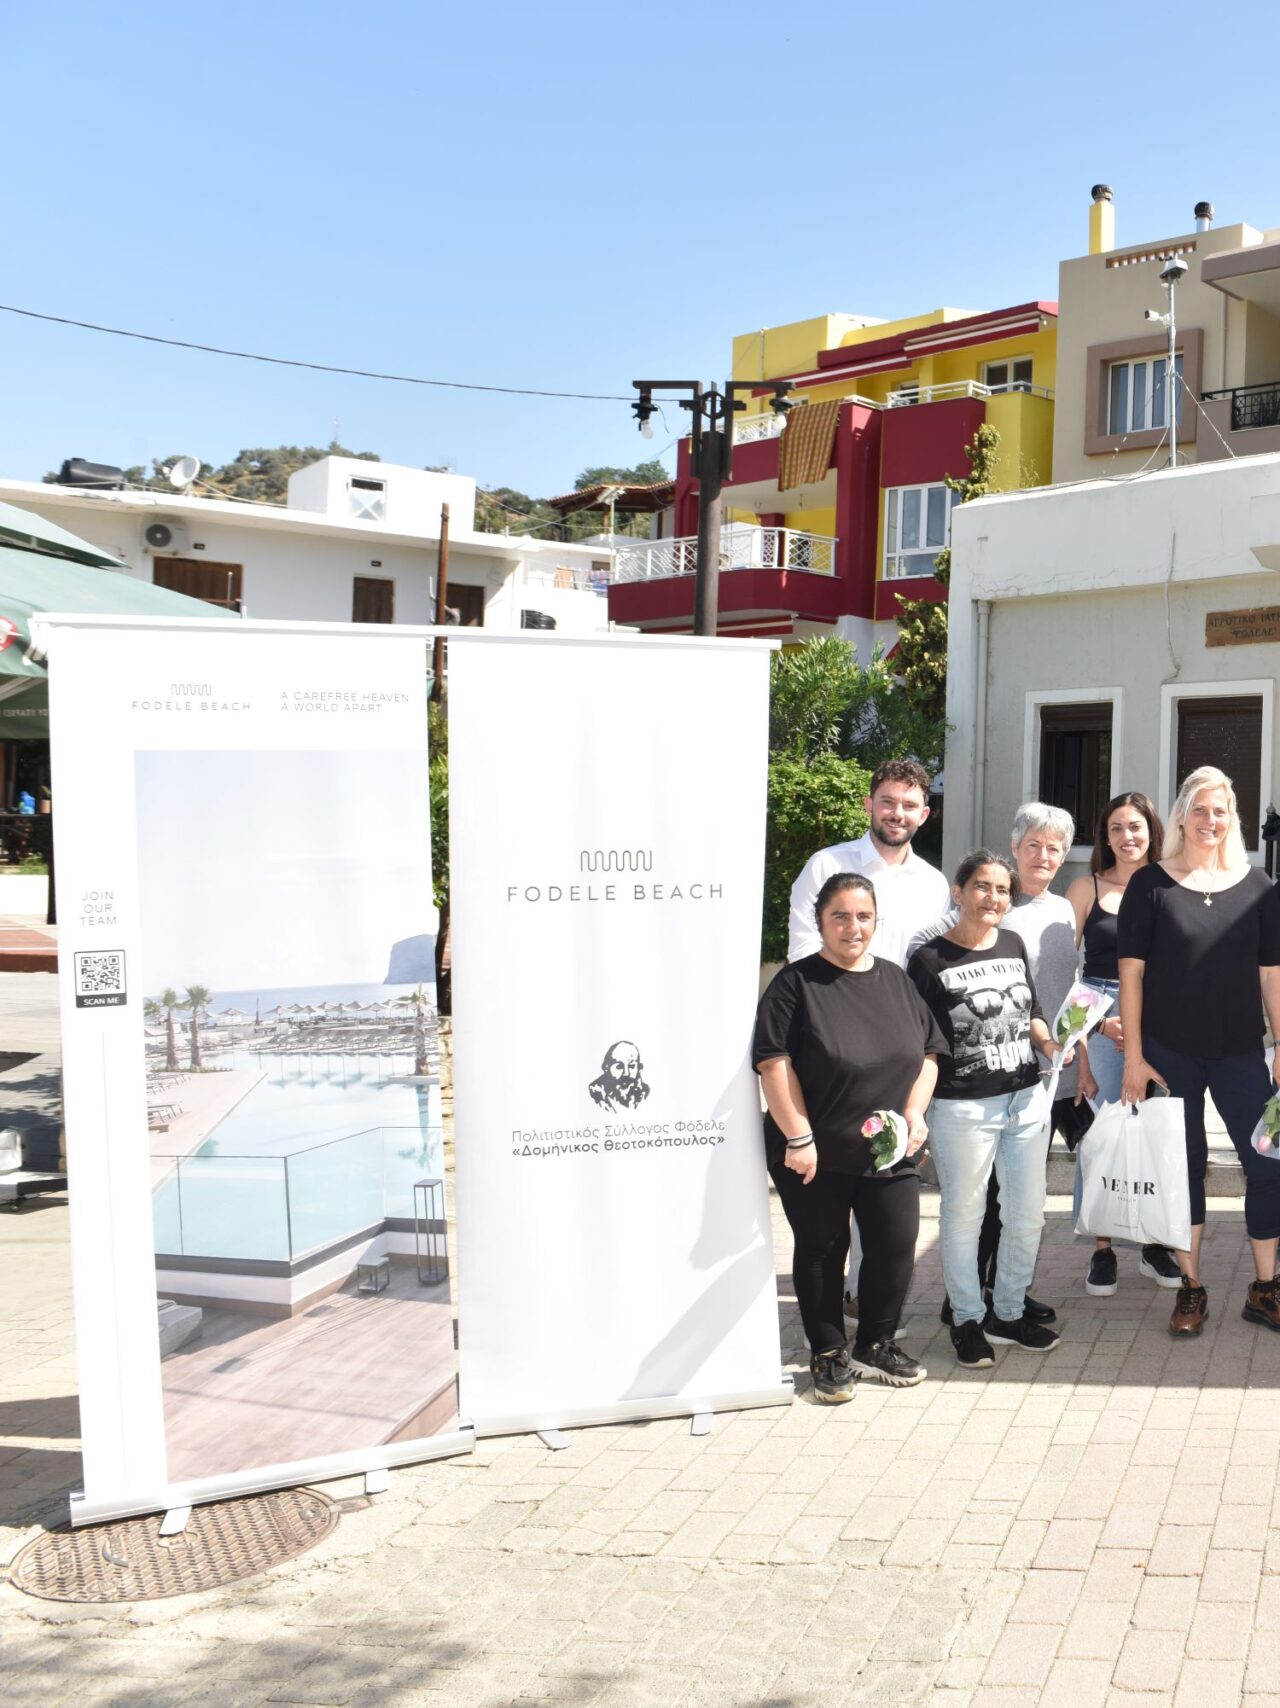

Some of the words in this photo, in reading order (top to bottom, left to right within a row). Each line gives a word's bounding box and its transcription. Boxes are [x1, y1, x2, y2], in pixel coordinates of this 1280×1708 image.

[280, 691, 289, 701] A
[294, 691, 358, 702] CAREFREE
[362, 692, 410, 703] HEAVEN
[132, 701, 192, 711] FODELE
[201, 702, 251, 711] BEACH
[280, 702, 289, 712] A
[294, 703, 339, 713] WORLD
[343, 703, 383, 713] APART
[82, 890, 114, 902] JOIN
[507, 884, 617, 903] FODELE
[633, 883, 723, 901] BEACH
[83, 903, 113, 914] OUR
[80, 915, 118, 926] TEAM
[956, 967, 988, 982] MAKE
[991, 963, 1007, 974] MY
[83, 997, 106, 1006] SCAN
[106, 996, 120, 1005] ME
[511, 1126, 600, 1143] Πολιτιστικός
[604, 1122, 669, 1138] Σύλλογος
[674, 1119, 726, 1133] Φόδελε
[511, 1141, 599, 1158] «Δομήνικος
[604, 1134, 726, 1151] Θεοτοκόπουλος»
